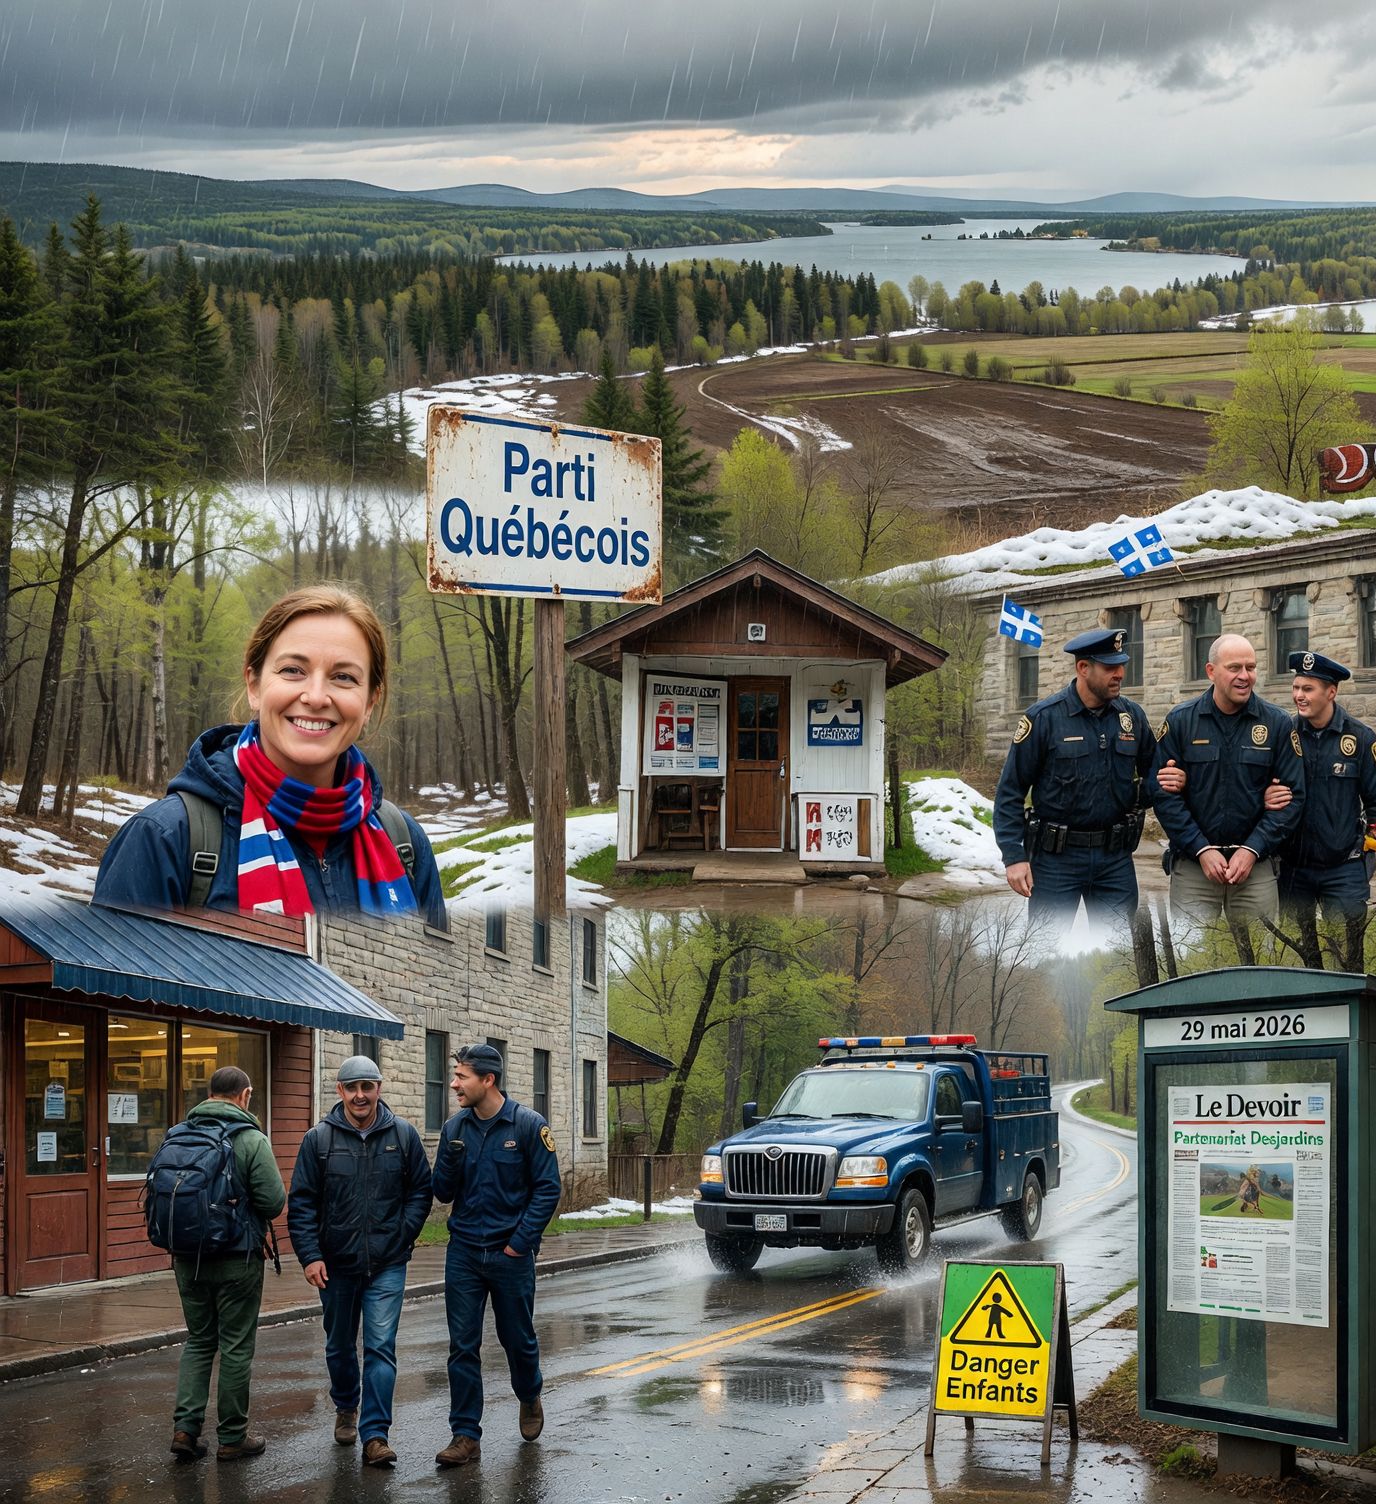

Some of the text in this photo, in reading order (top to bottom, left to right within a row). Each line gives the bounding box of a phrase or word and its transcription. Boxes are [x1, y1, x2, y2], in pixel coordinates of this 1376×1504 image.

[504, 441, 595, 502] Parti
[440, 497, 650, 568] Québécois
[1181, 1014, 1305, 1041] 29 mai 2026
[1195, 1094, 1222, 1118] Le
[1226, 1093, 1301, 1118] Devoir
[951, 1350, 1040, 1380] Danger
[947, 1377, 1038, 1404] Enfants
